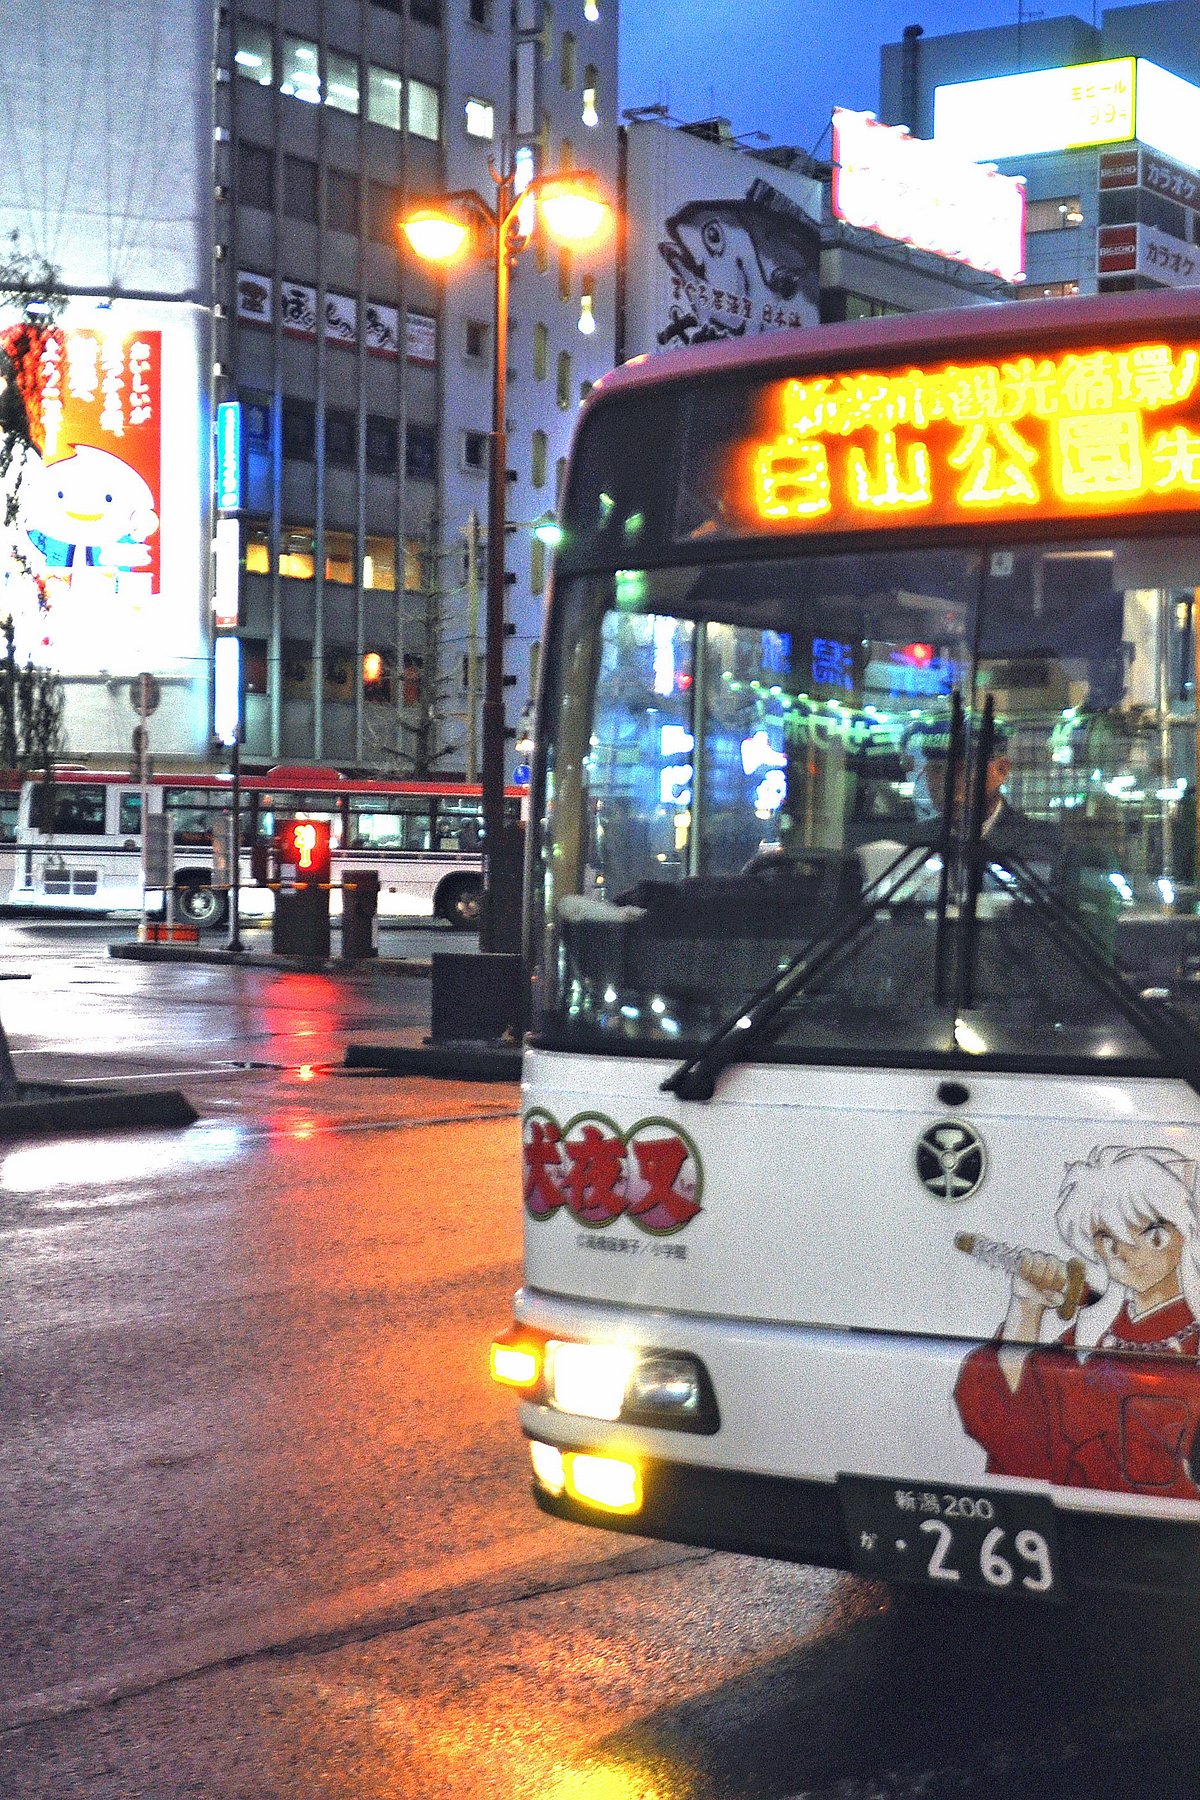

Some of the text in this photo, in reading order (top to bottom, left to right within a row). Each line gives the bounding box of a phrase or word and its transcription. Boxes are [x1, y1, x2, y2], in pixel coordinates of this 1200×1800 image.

[1147, 163, 1196, 200] カラオケ
[1146, 242, 1195, 276] カラオケ
[523, 1120, 704, 1222] 犬夜叉
